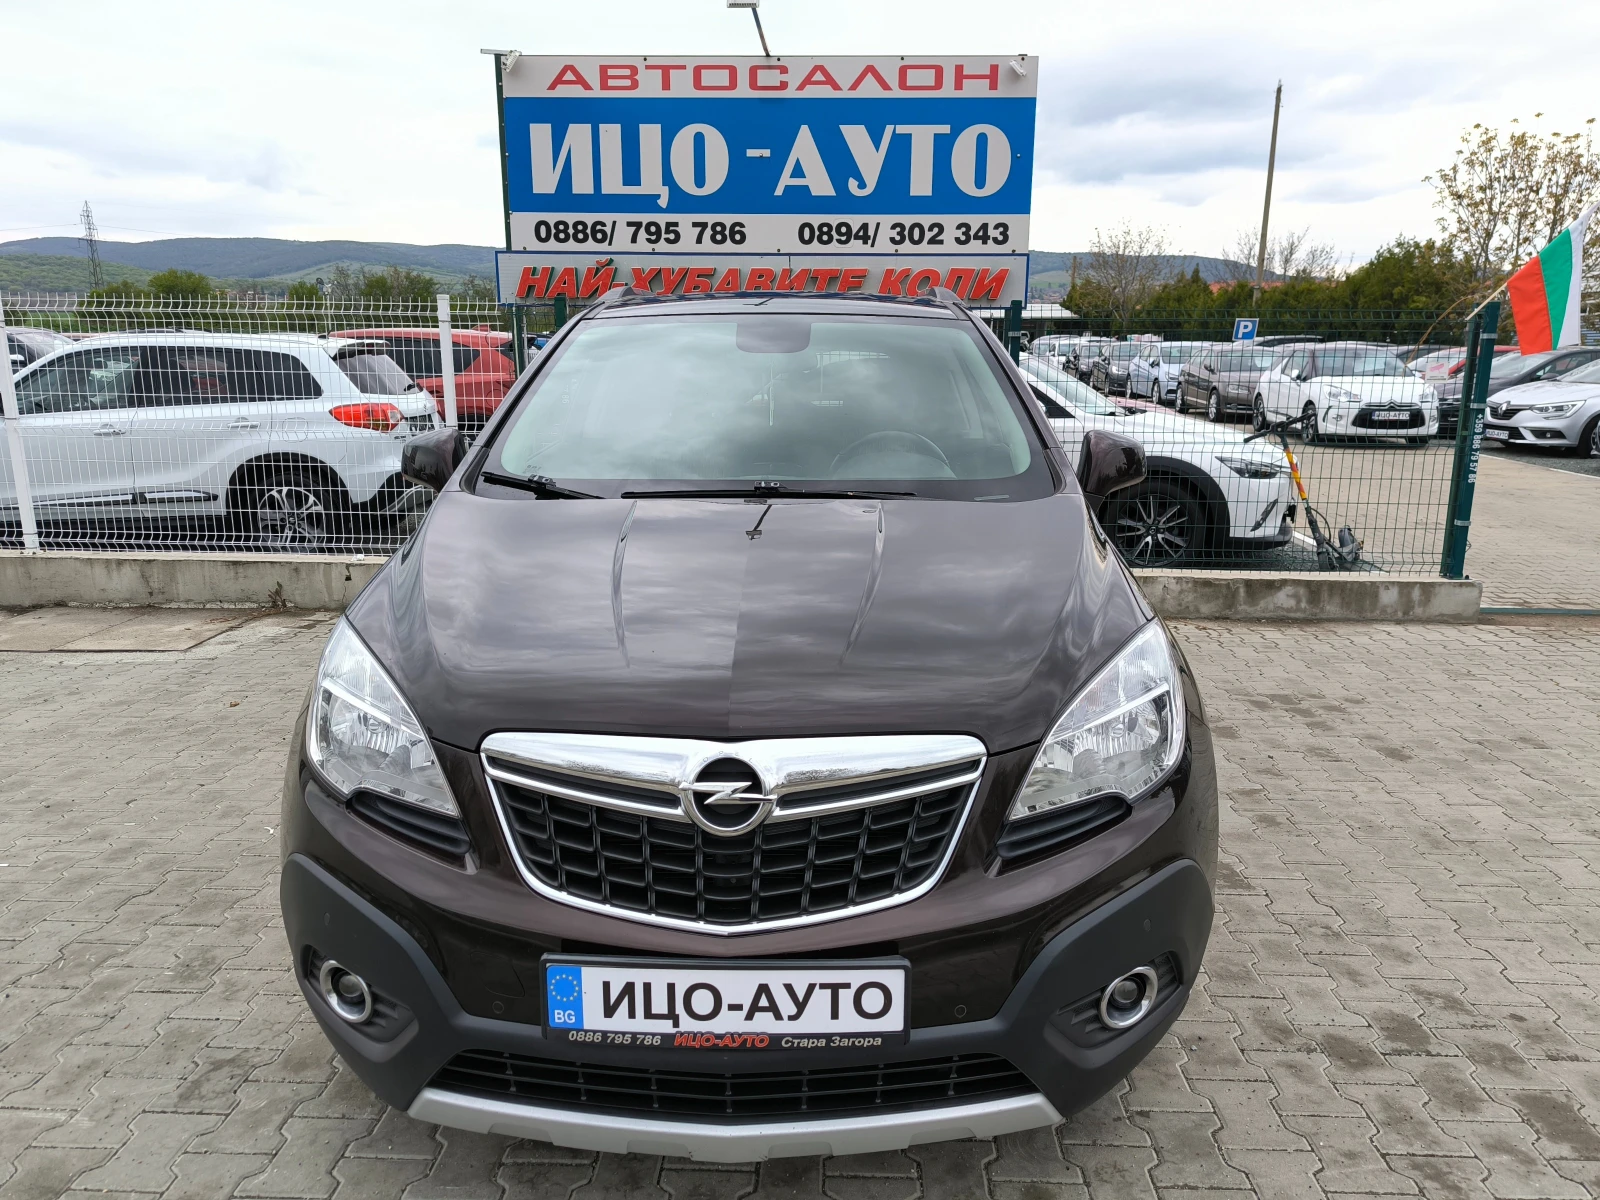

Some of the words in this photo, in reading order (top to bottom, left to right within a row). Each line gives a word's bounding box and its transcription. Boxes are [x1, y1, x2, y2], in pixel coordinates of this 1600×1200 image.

[546, 64, 999, 91] АВТОСАЛОН
[534, 220, 616, 245] 0886/
[626, 221, 681, 245] 795
[692, 221, 747, 245] 786
[798, 222, 880, 247] 0894/
[889, 223, 944, 245] 302
[954, 223, 1010, 246] 343
[1238, 321, 1252, 338] P
[1475, 414, 1483, 432] +359
[1472, 435, 1481, 449] 886
[1471, 450, 1479, 460] 79
[1470, 462, 1477, 471] 57
[602, 980, 893, 1028] ИЦО-АУТО
[554, 1010, 576, 1023] BG
[568, 1030, 602, 1043] 0886
[606, 1032, 632, 1044] 795
[636, 1033, 661, 1045] 786
[674, 1032, 770, 1048] ИЦО-АУТО
[781, 1036, 826, 1048] Стара
[830, 1036, 882, 1048] Загора
